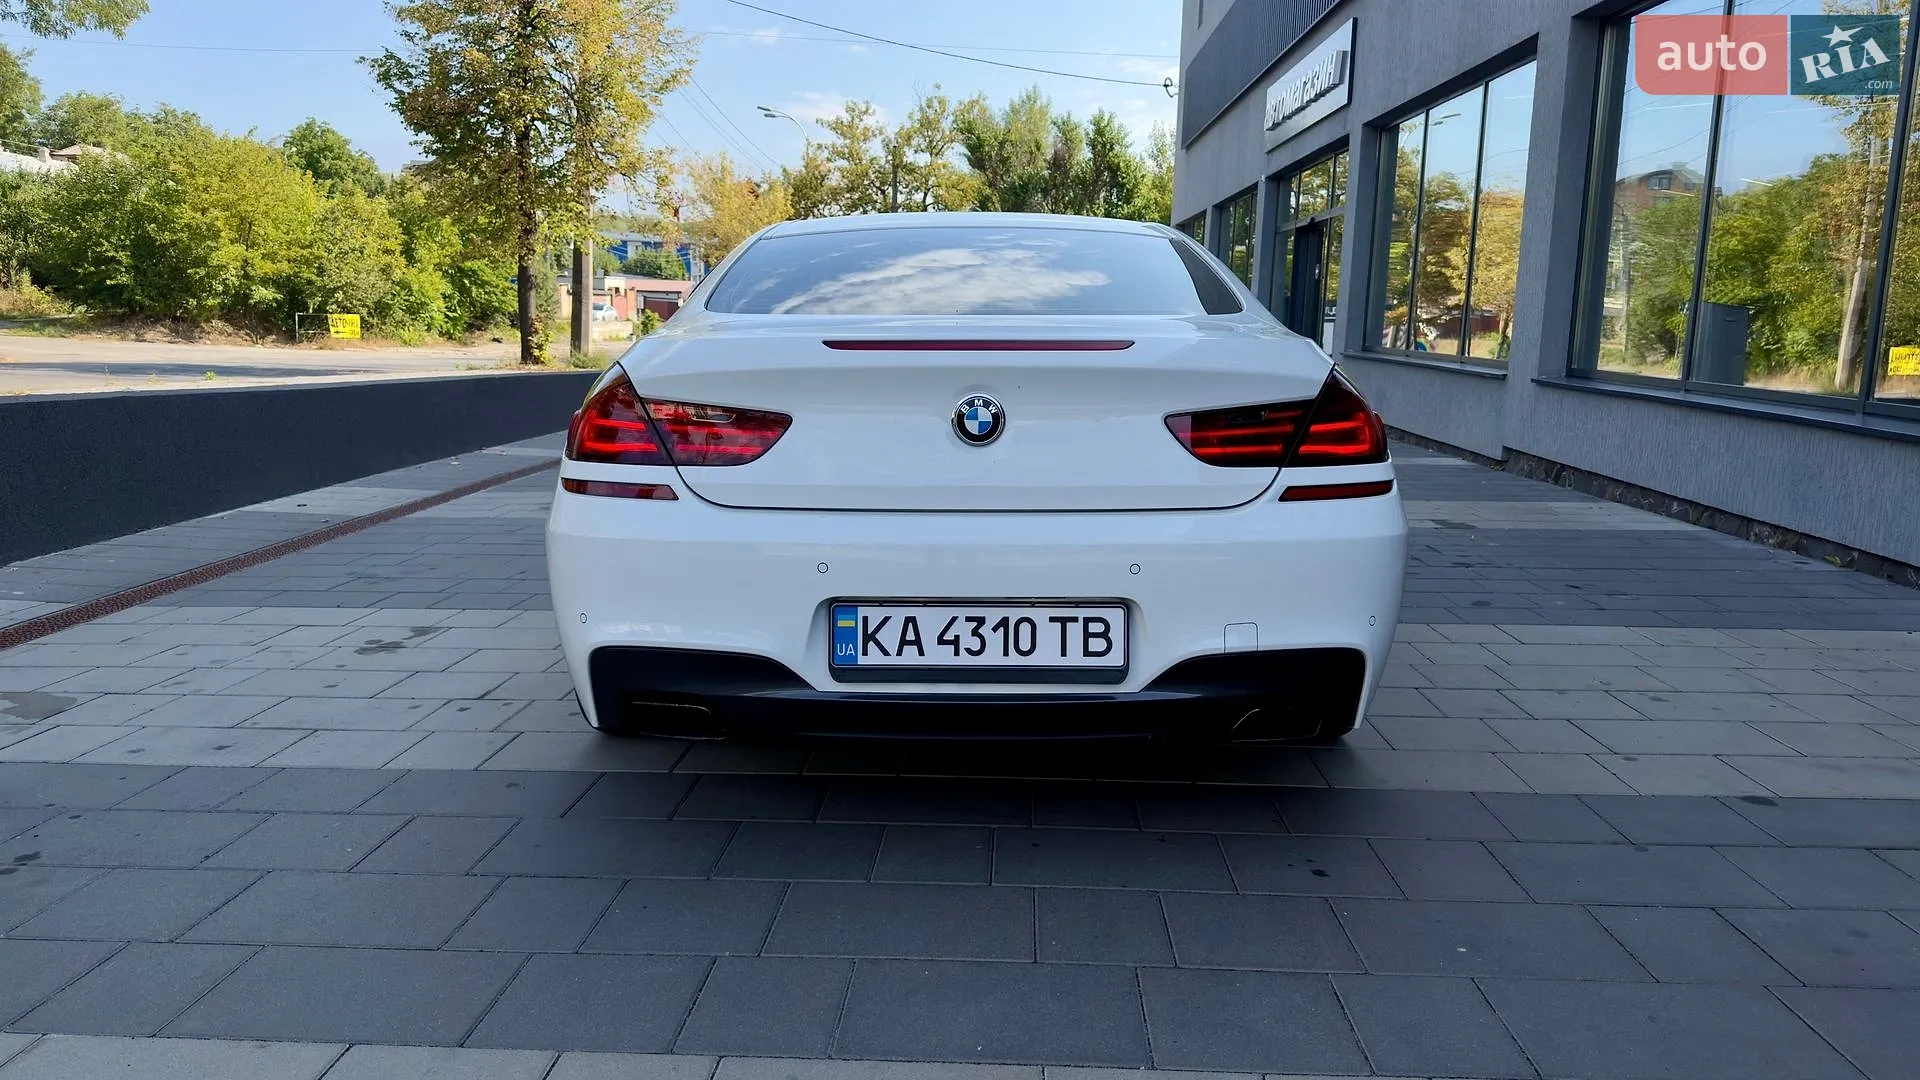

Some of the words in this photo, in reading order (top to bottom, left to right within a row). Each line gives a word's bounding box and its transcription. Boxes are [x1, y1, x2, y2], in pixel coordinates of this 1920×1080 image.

[960, 399, 998, 414] BMW
[861, 615, 926, 657] KA
[936, 615, 1037, 657] 4310
[1048, 616, 1113, 658] TB
[837, 643, 856, 657] UA
